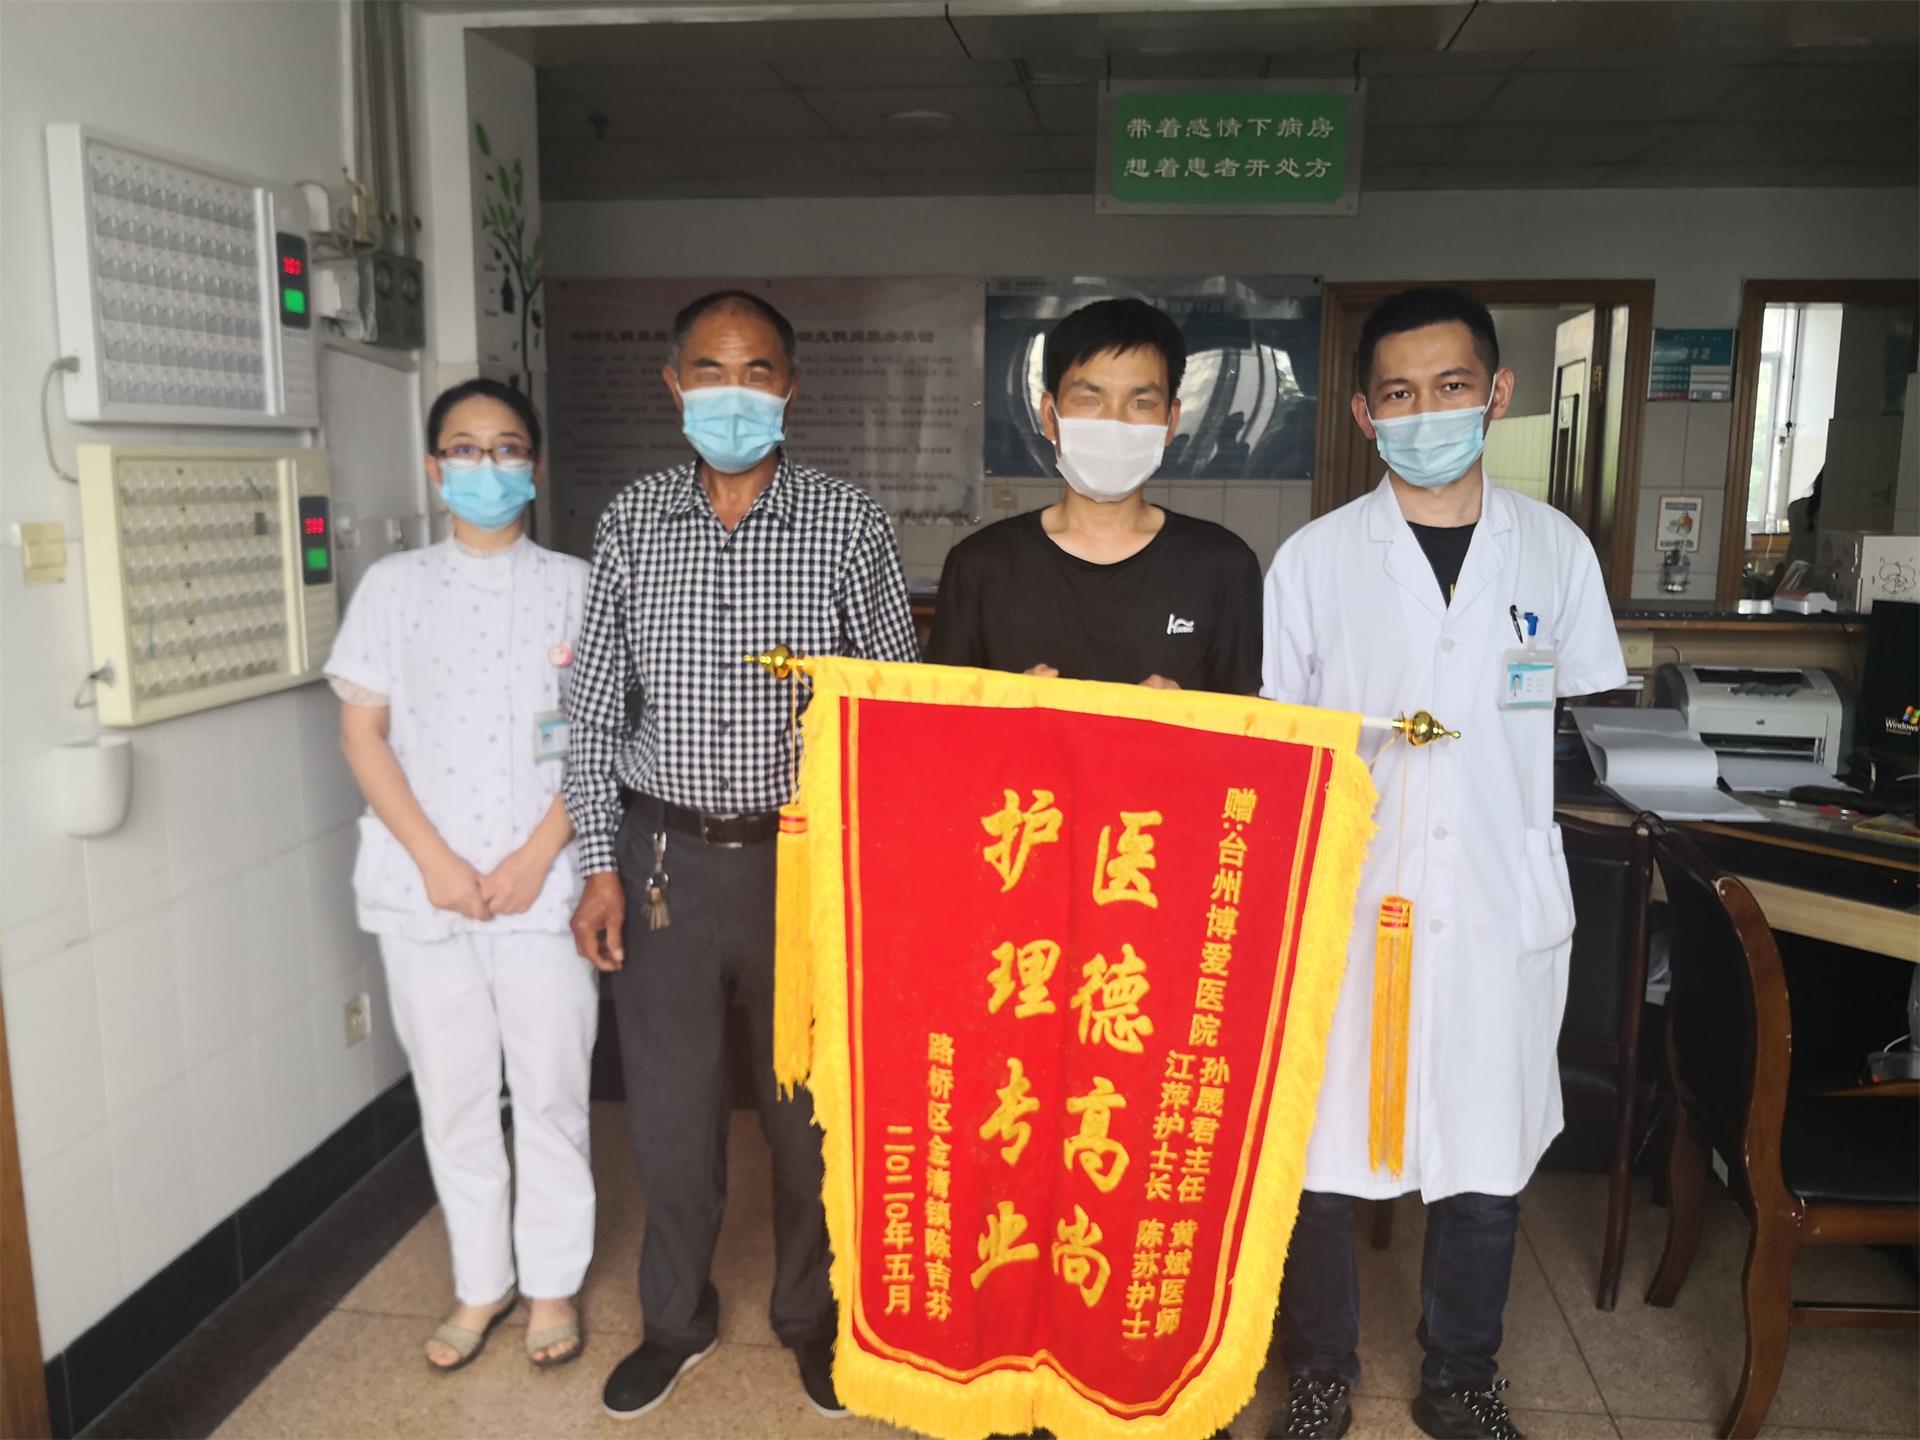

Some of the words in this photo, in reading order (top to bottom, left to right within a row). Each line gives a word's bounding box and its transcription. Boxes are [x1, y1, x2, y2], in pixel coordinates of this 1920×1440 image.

[1123, 157, 1332, 179] 想着患者开处方
[1126, 116, 1334, 139] 带着感情下病房
[970, 788, 1064, 1290] 护理专业
[1052, 809, 1163, 1308] 医德高尚
[1144, 1049, 1197, 1202] 江萍护士长
[1121, 1217, 1166, 1340] 陈苏护士
